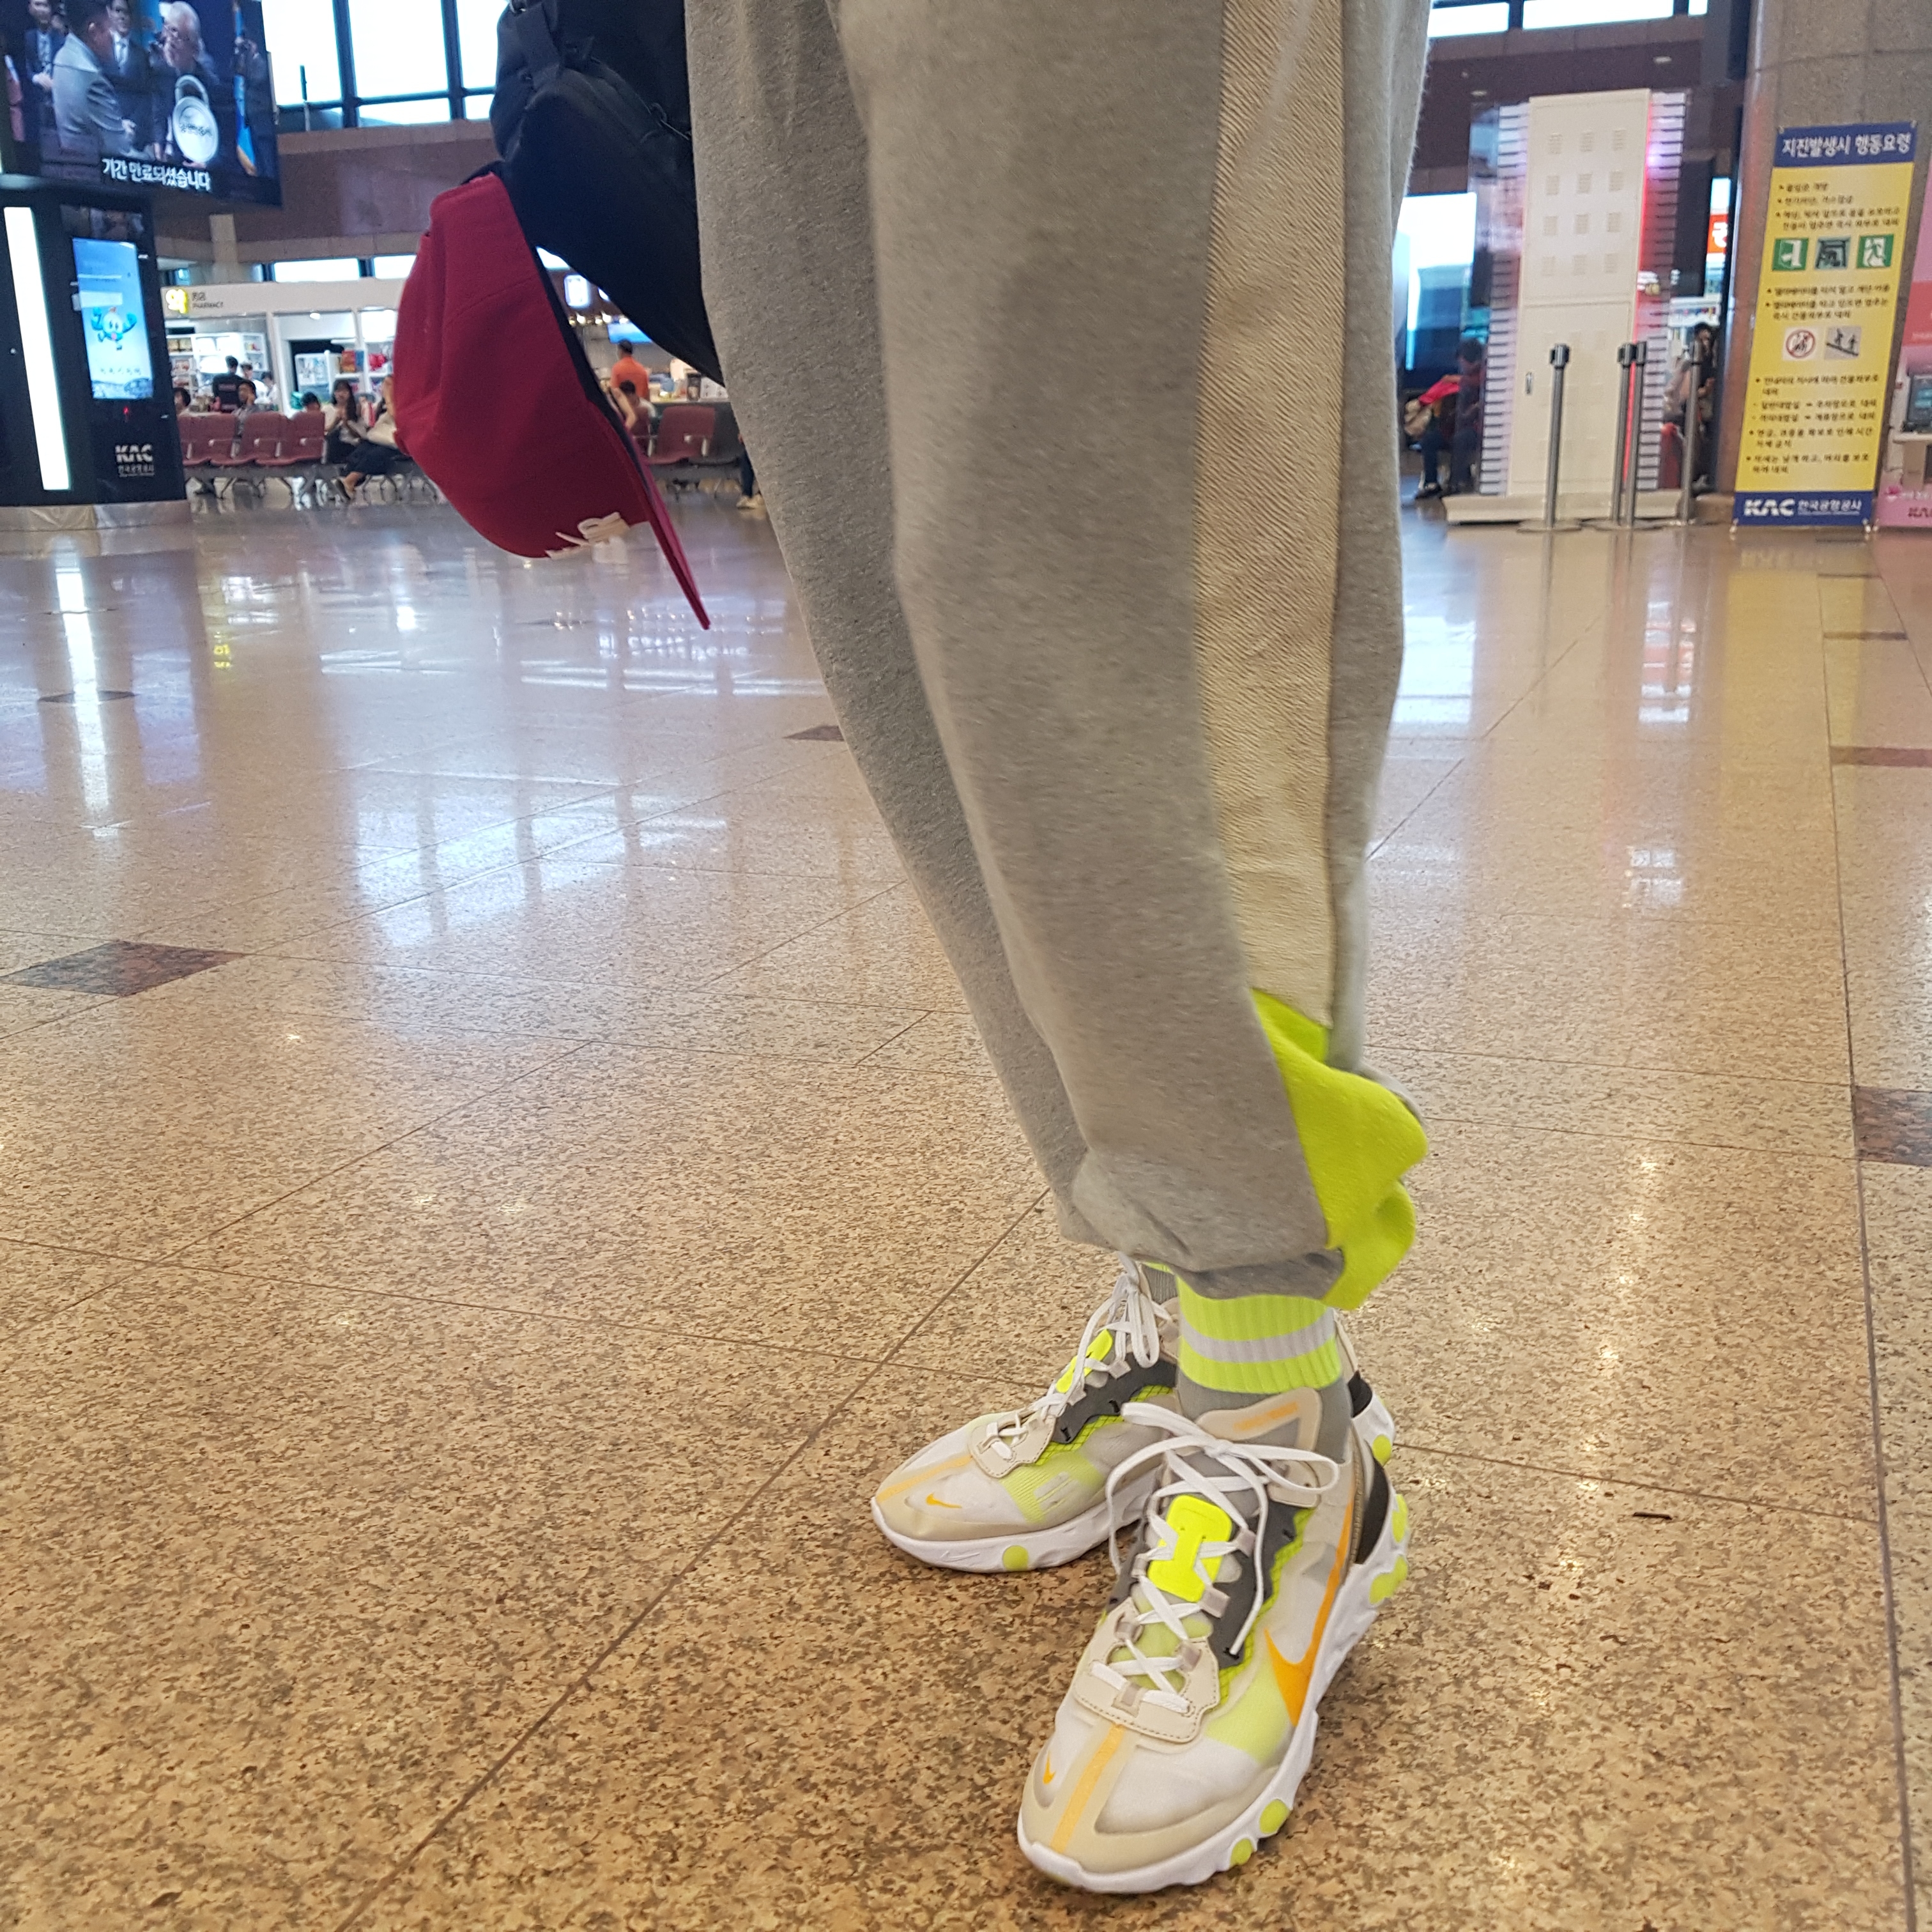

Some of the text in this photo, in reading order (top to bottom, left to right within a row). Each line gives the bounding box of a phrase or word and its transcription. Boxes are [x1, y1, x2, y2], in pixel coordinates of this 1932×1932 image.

[1782, 132, 1912, 158] 지진발생시 행동요령
[102, 158, 127, 180] 기간
[115, 443, 153, 463] KAC
[1744, 498, 1796, 517] KAC
